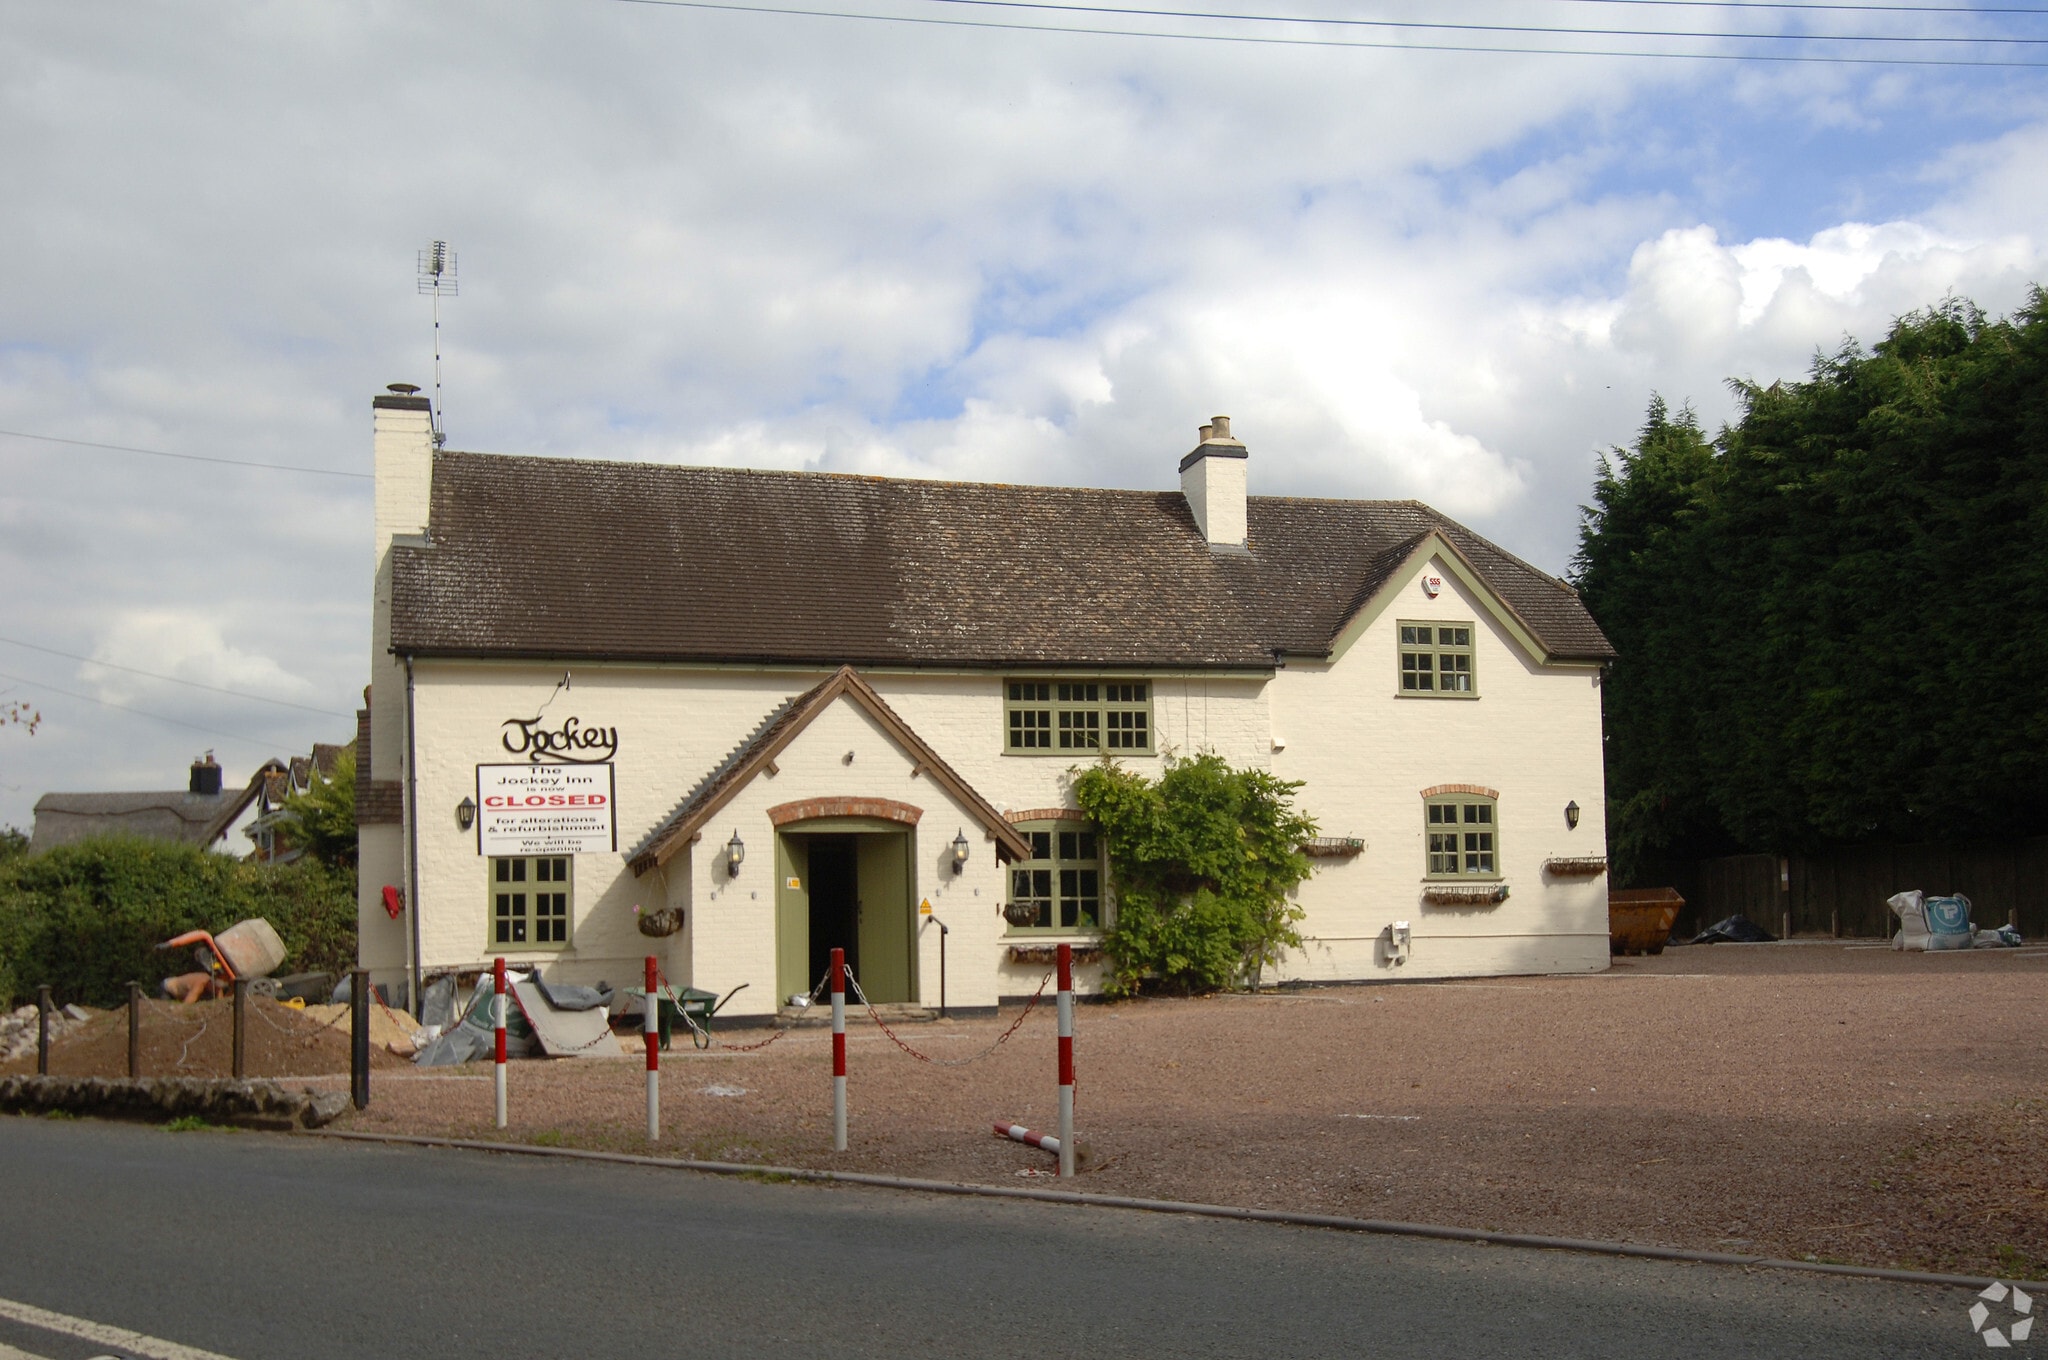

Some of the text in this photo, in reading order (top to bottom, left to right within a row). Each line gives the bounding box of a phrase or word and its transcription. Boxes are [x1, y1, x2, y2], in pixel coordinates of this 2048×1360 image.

[501, 715, 618, 762] Jockey
[528, 766, 562, 775] The
[497, 775, 593, 786] Jockey Inn
[485, 794, 607, 807] CLOSED
[496, 816, 597, 825] for alterations
[488, 824, 606, 833] & refurbishment
